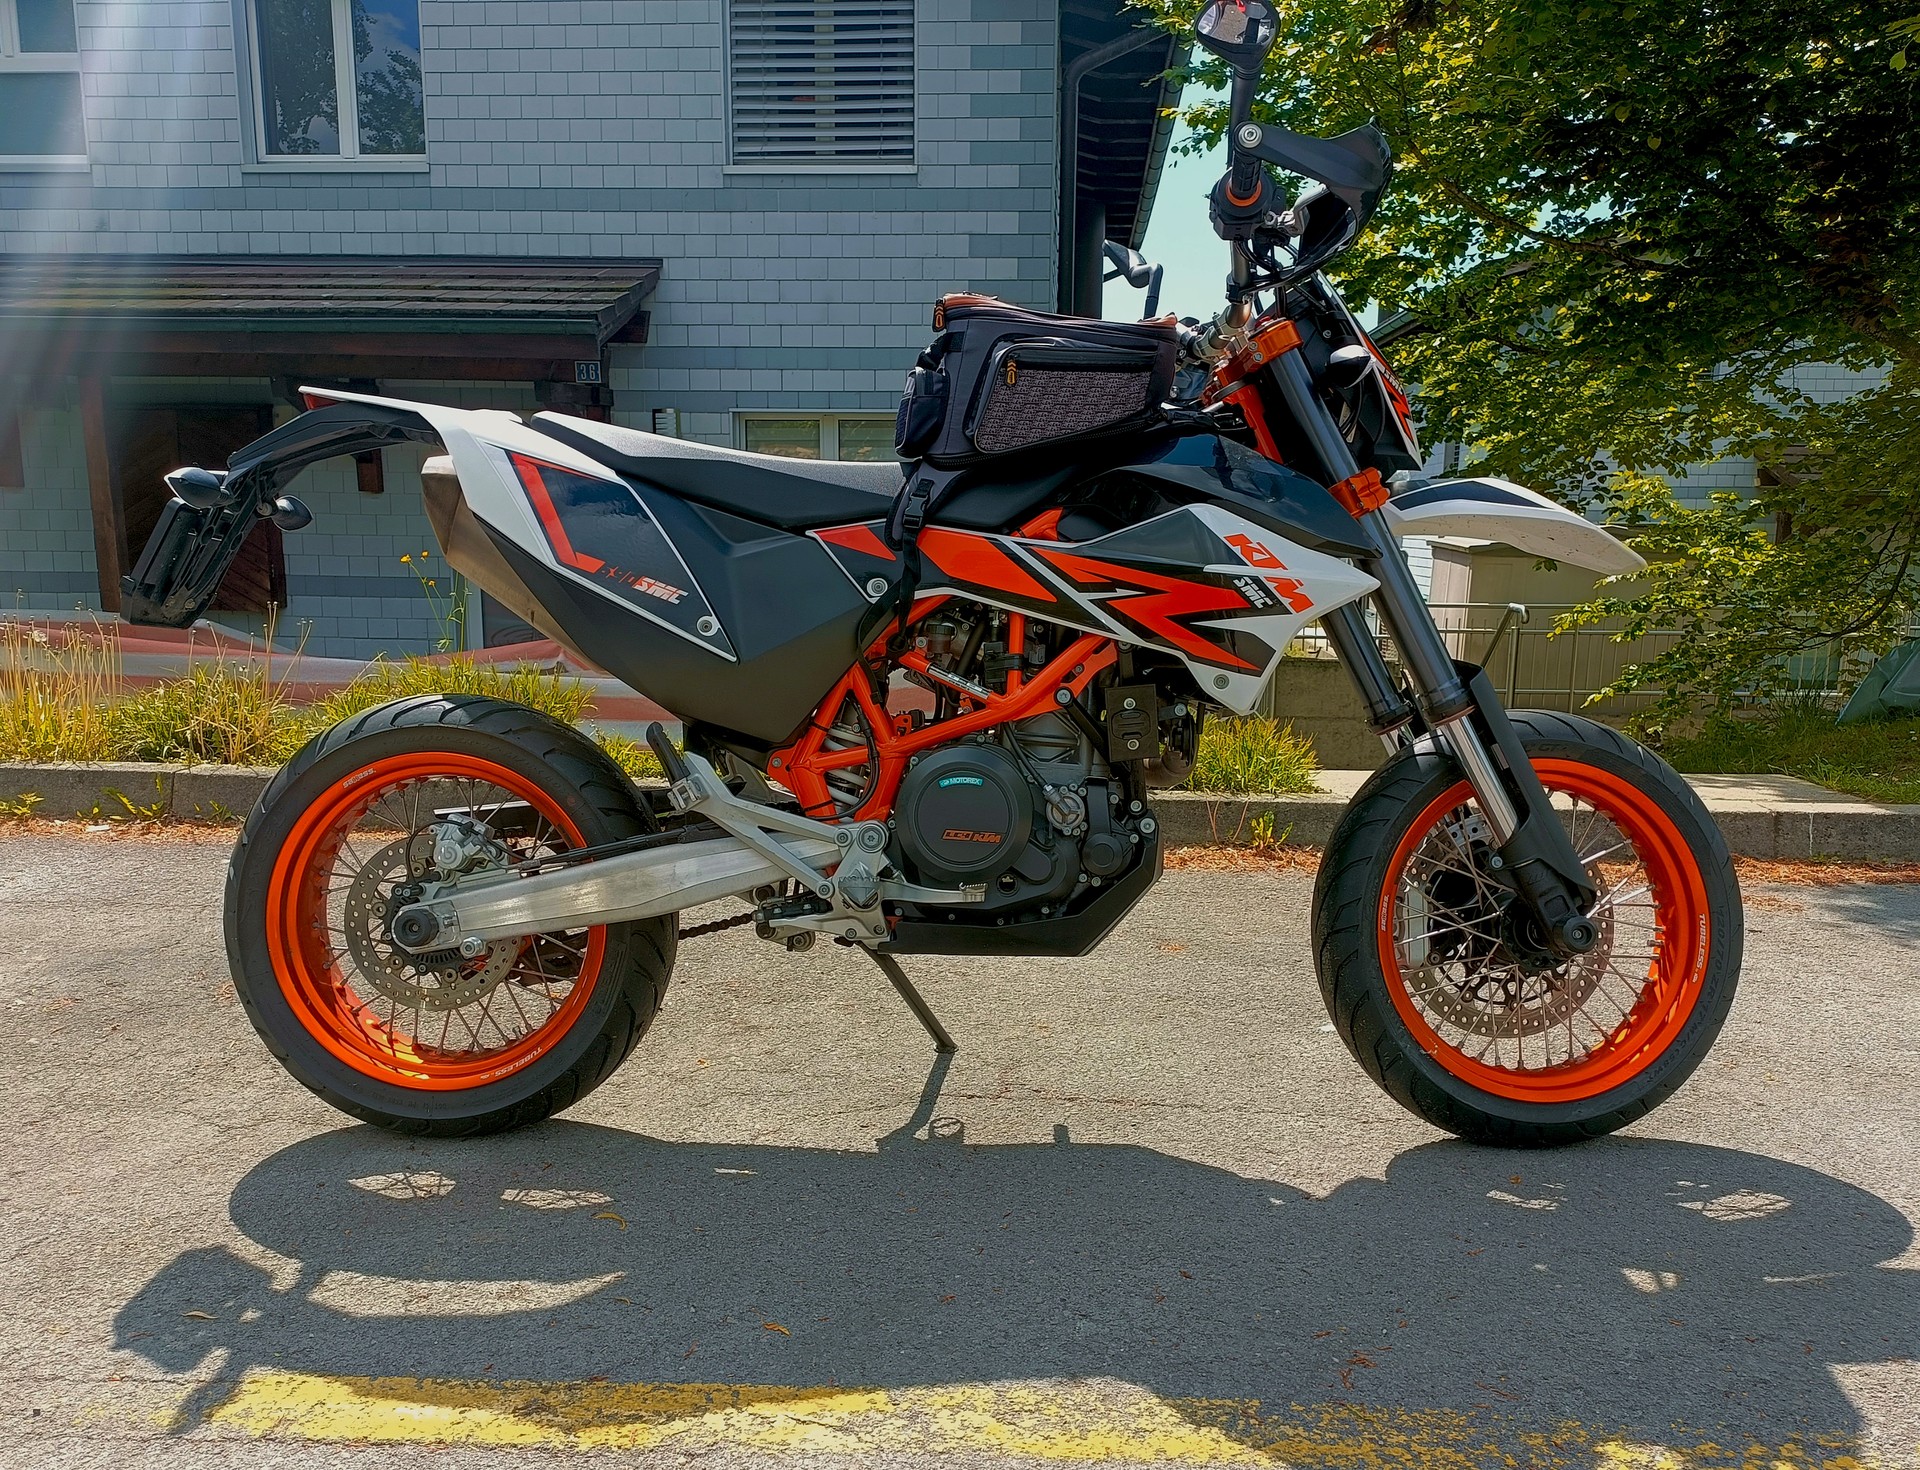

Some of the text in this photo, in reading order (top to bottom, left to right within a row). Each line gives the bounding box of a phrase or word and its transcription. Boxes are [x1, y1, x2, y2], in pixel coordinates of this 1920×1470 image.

[580, 363, 596, 380] 36
[1223, 533, 1315, 614] KTM
[632, 575, 689, 605] SMC
[1233, 576, 1274, 609] SMC
[950, 776, 981, 785] MOTOREX
[1697, 913, 1707, 969] TUBELESS
[495, 1047, 543, 1077] TUBELESS
